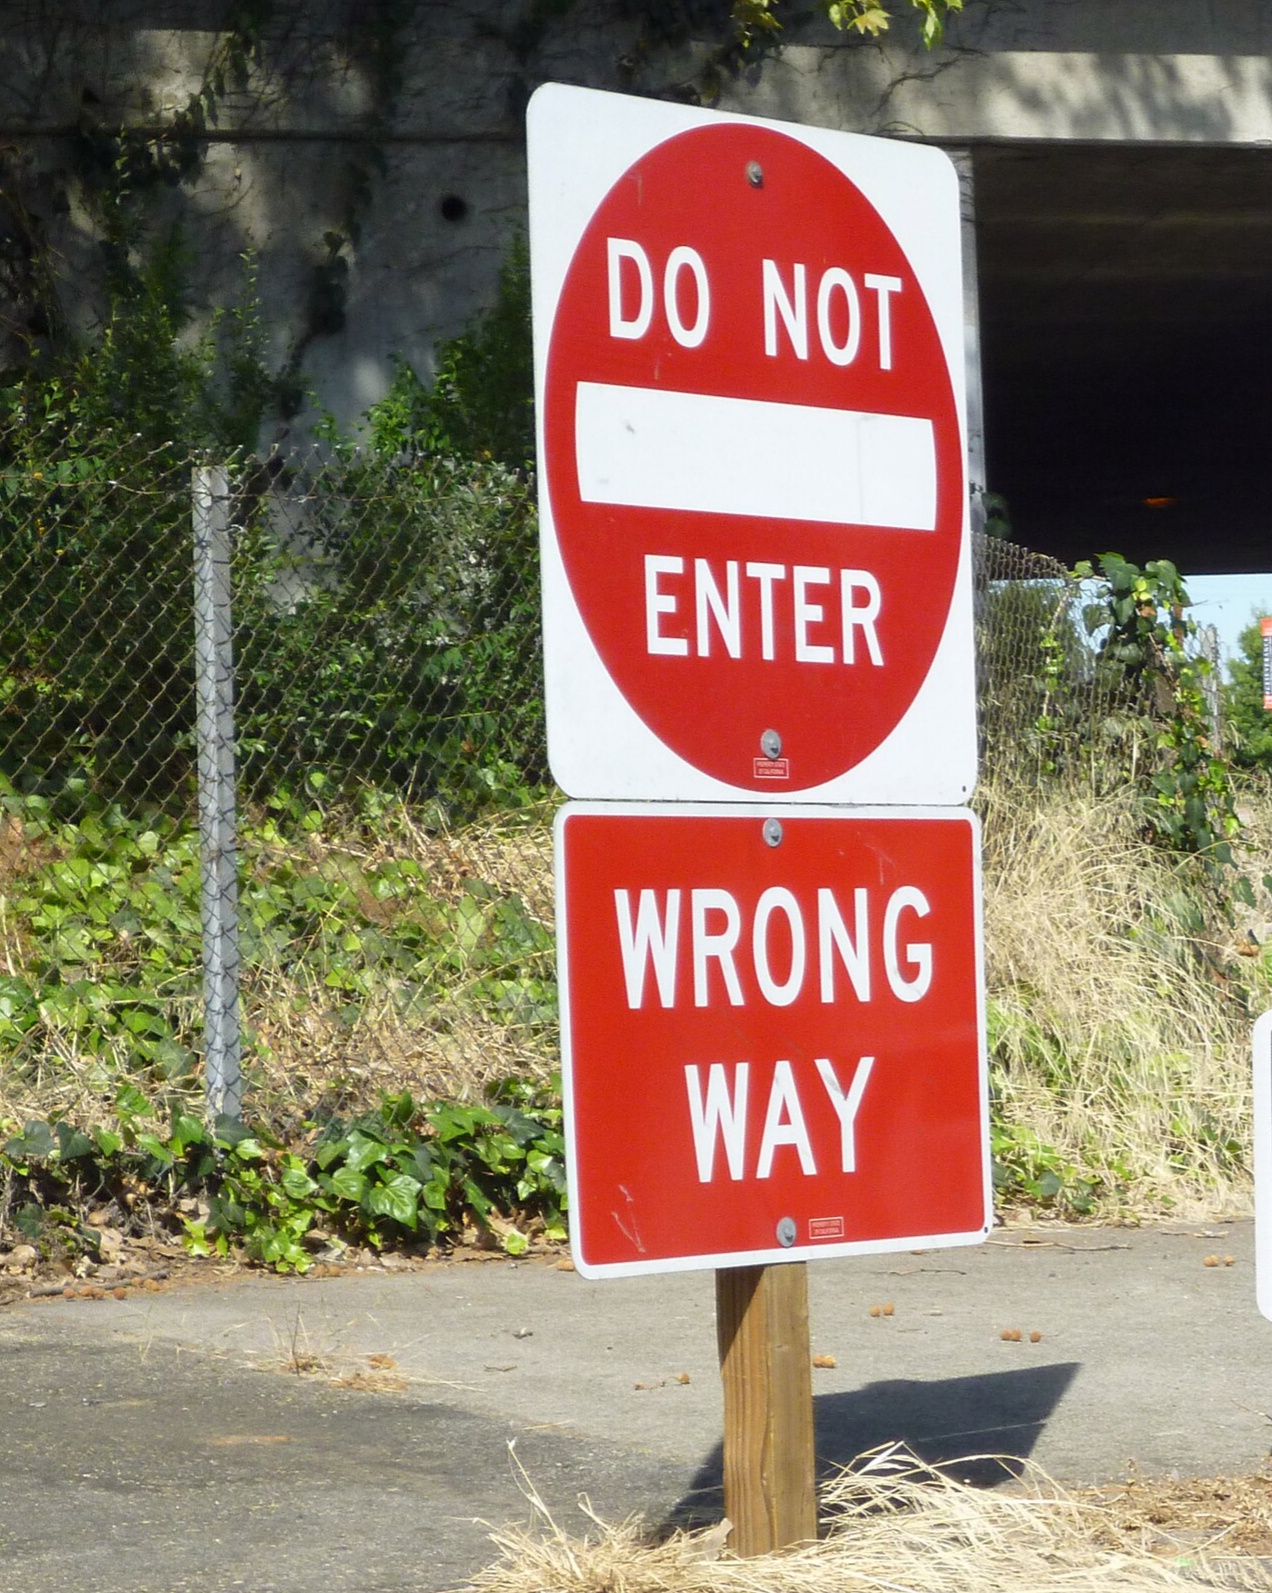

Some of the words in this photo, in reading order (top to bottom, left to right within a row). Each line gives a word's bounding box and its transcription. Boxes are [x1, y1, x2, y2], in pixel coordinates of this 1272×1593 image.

[606, 237, 711, 348] DO
[763, 259, 903, 371] NOT
[644, 554, 886, 667] ENTER
[614, 885, 934, 1010] WRONG
[684, 1056, 875, 1184] WAY
